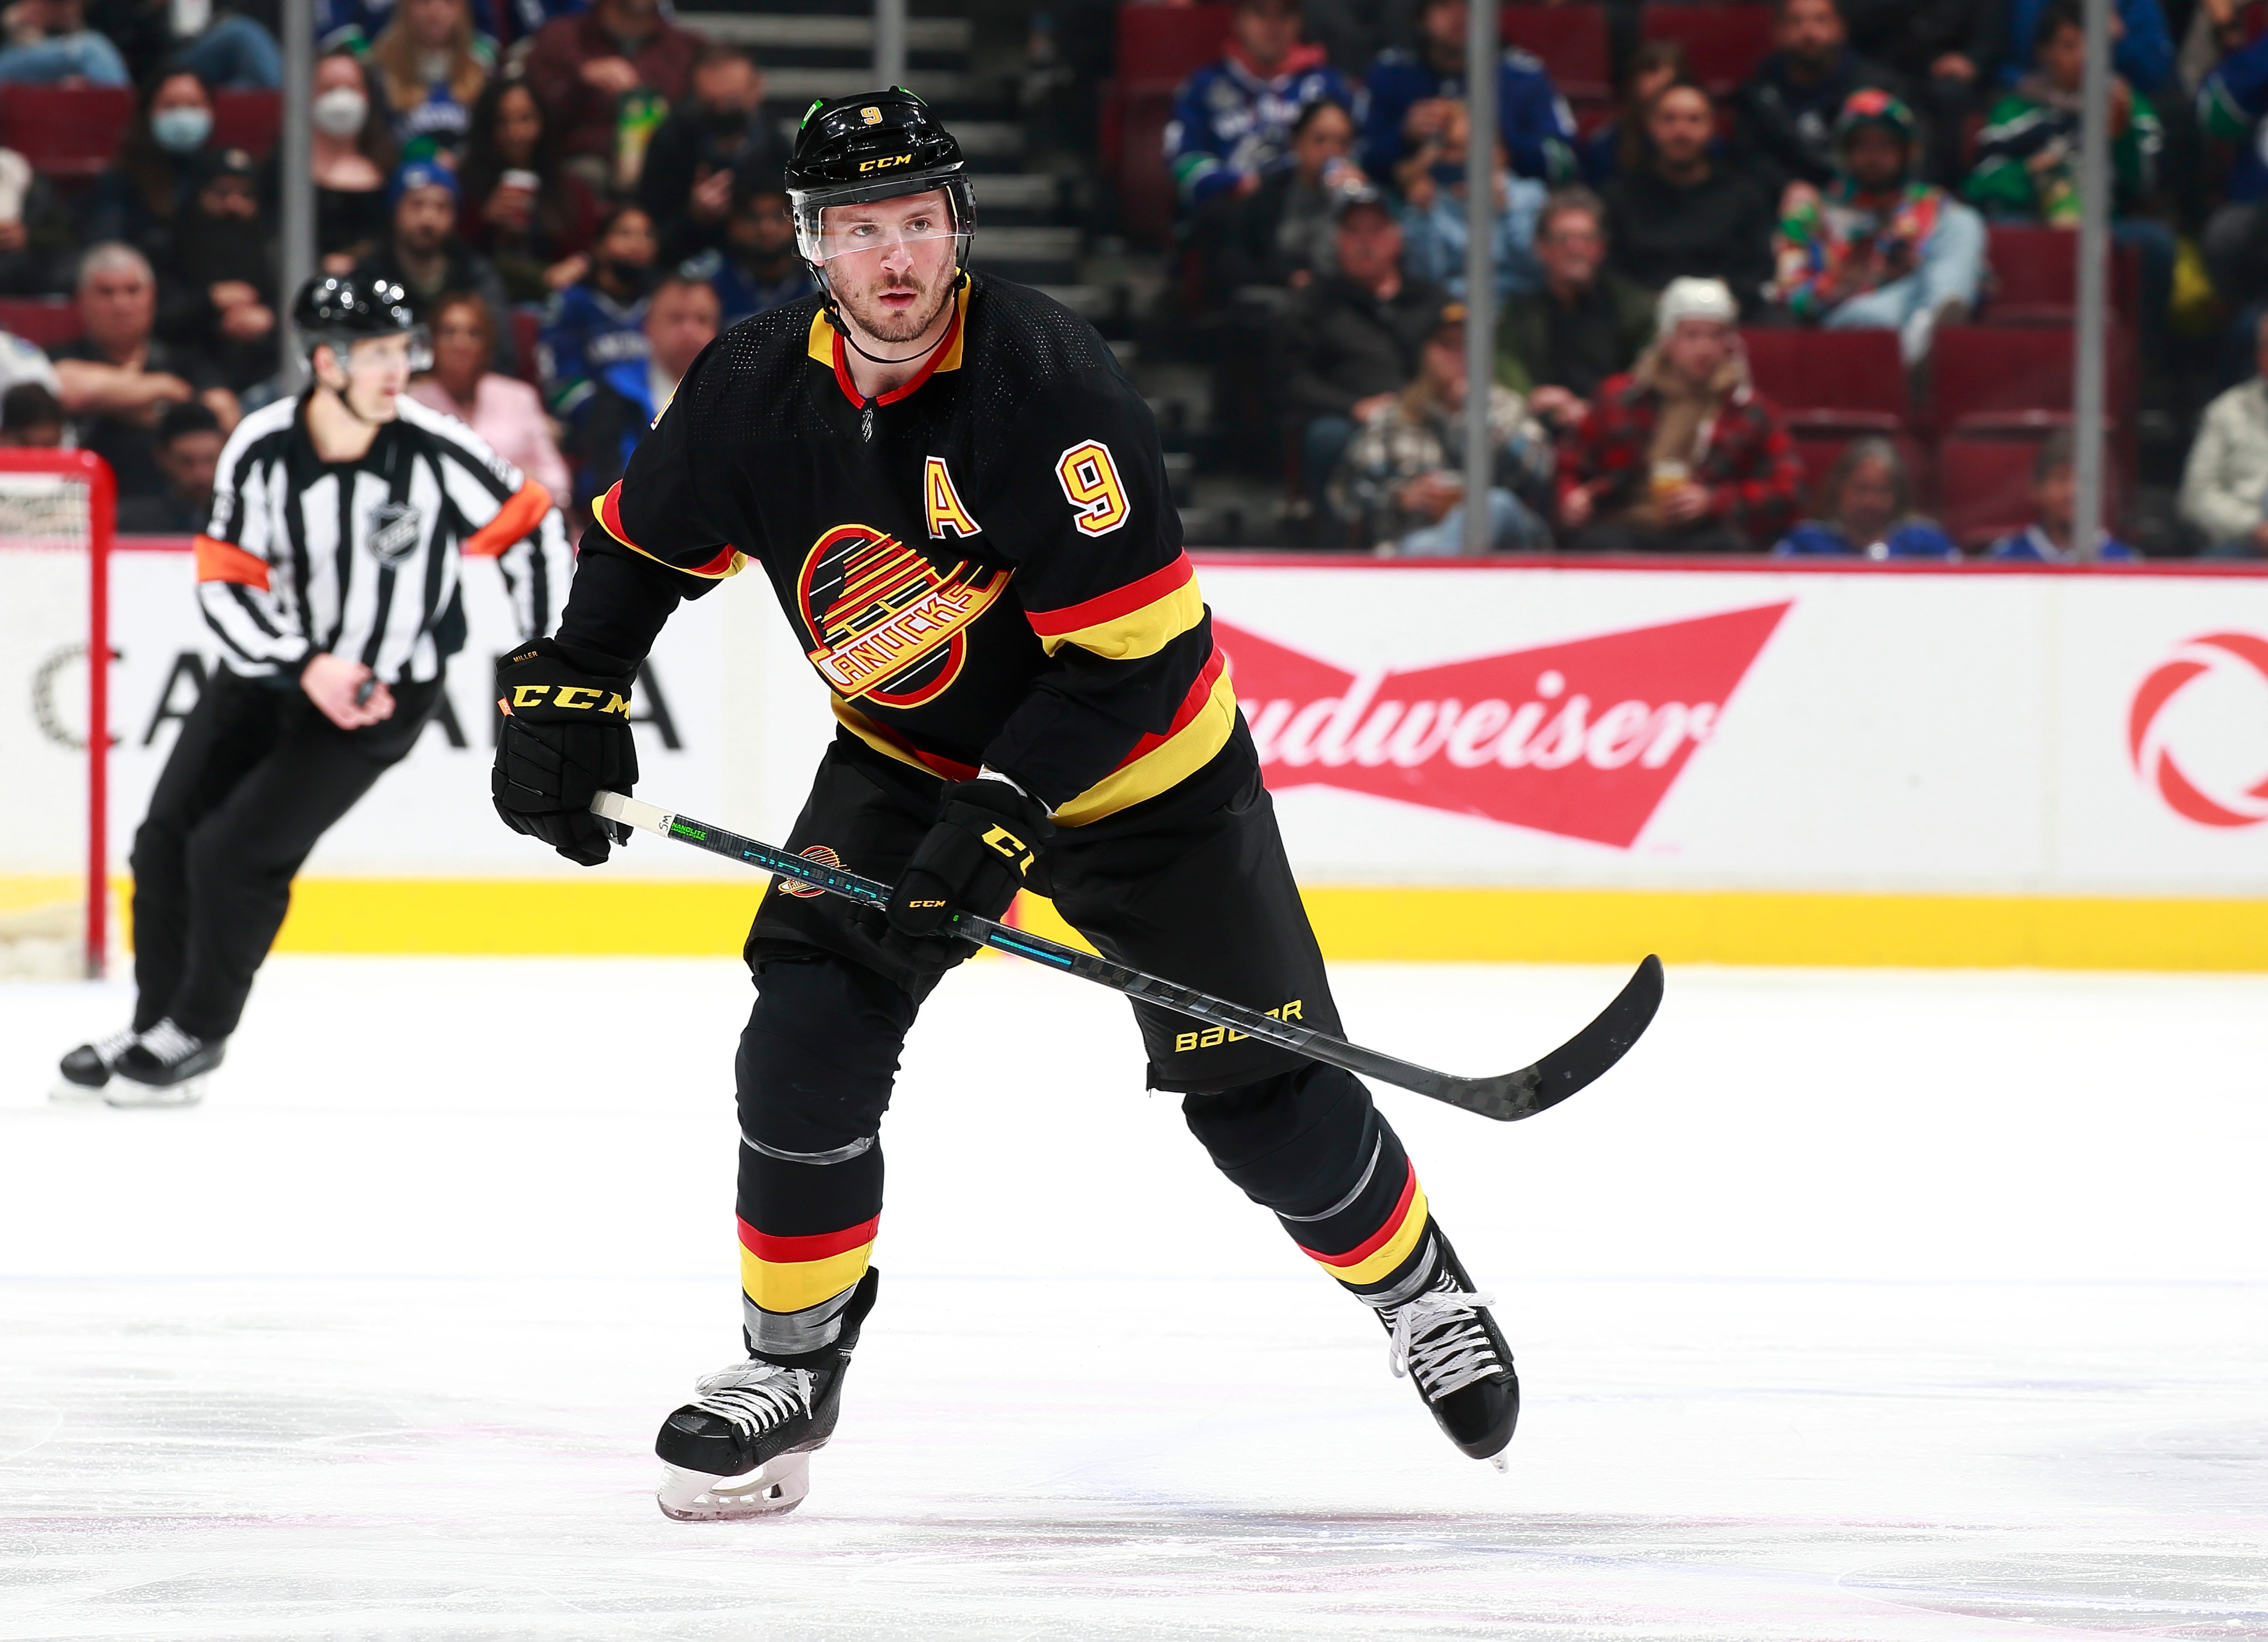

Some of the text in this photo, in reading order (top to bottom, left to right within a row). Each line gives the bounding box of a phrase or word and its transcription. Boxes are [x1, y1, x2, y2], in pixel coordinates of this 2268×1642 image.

[860, 107, 883, 125] 9
[859, 154, 912, 172] CCM
[924, 455, 982, 540] A
[1055, 439, 1131, 538] 9
[513, 651, 538, 663] MILLER
[513, 685, 631, 720] CCM
[1226, 653, 1720, 769] udweiser
[671, 822, 707, 838] NANOLITE
[909, 900, 946, 908] CCM
